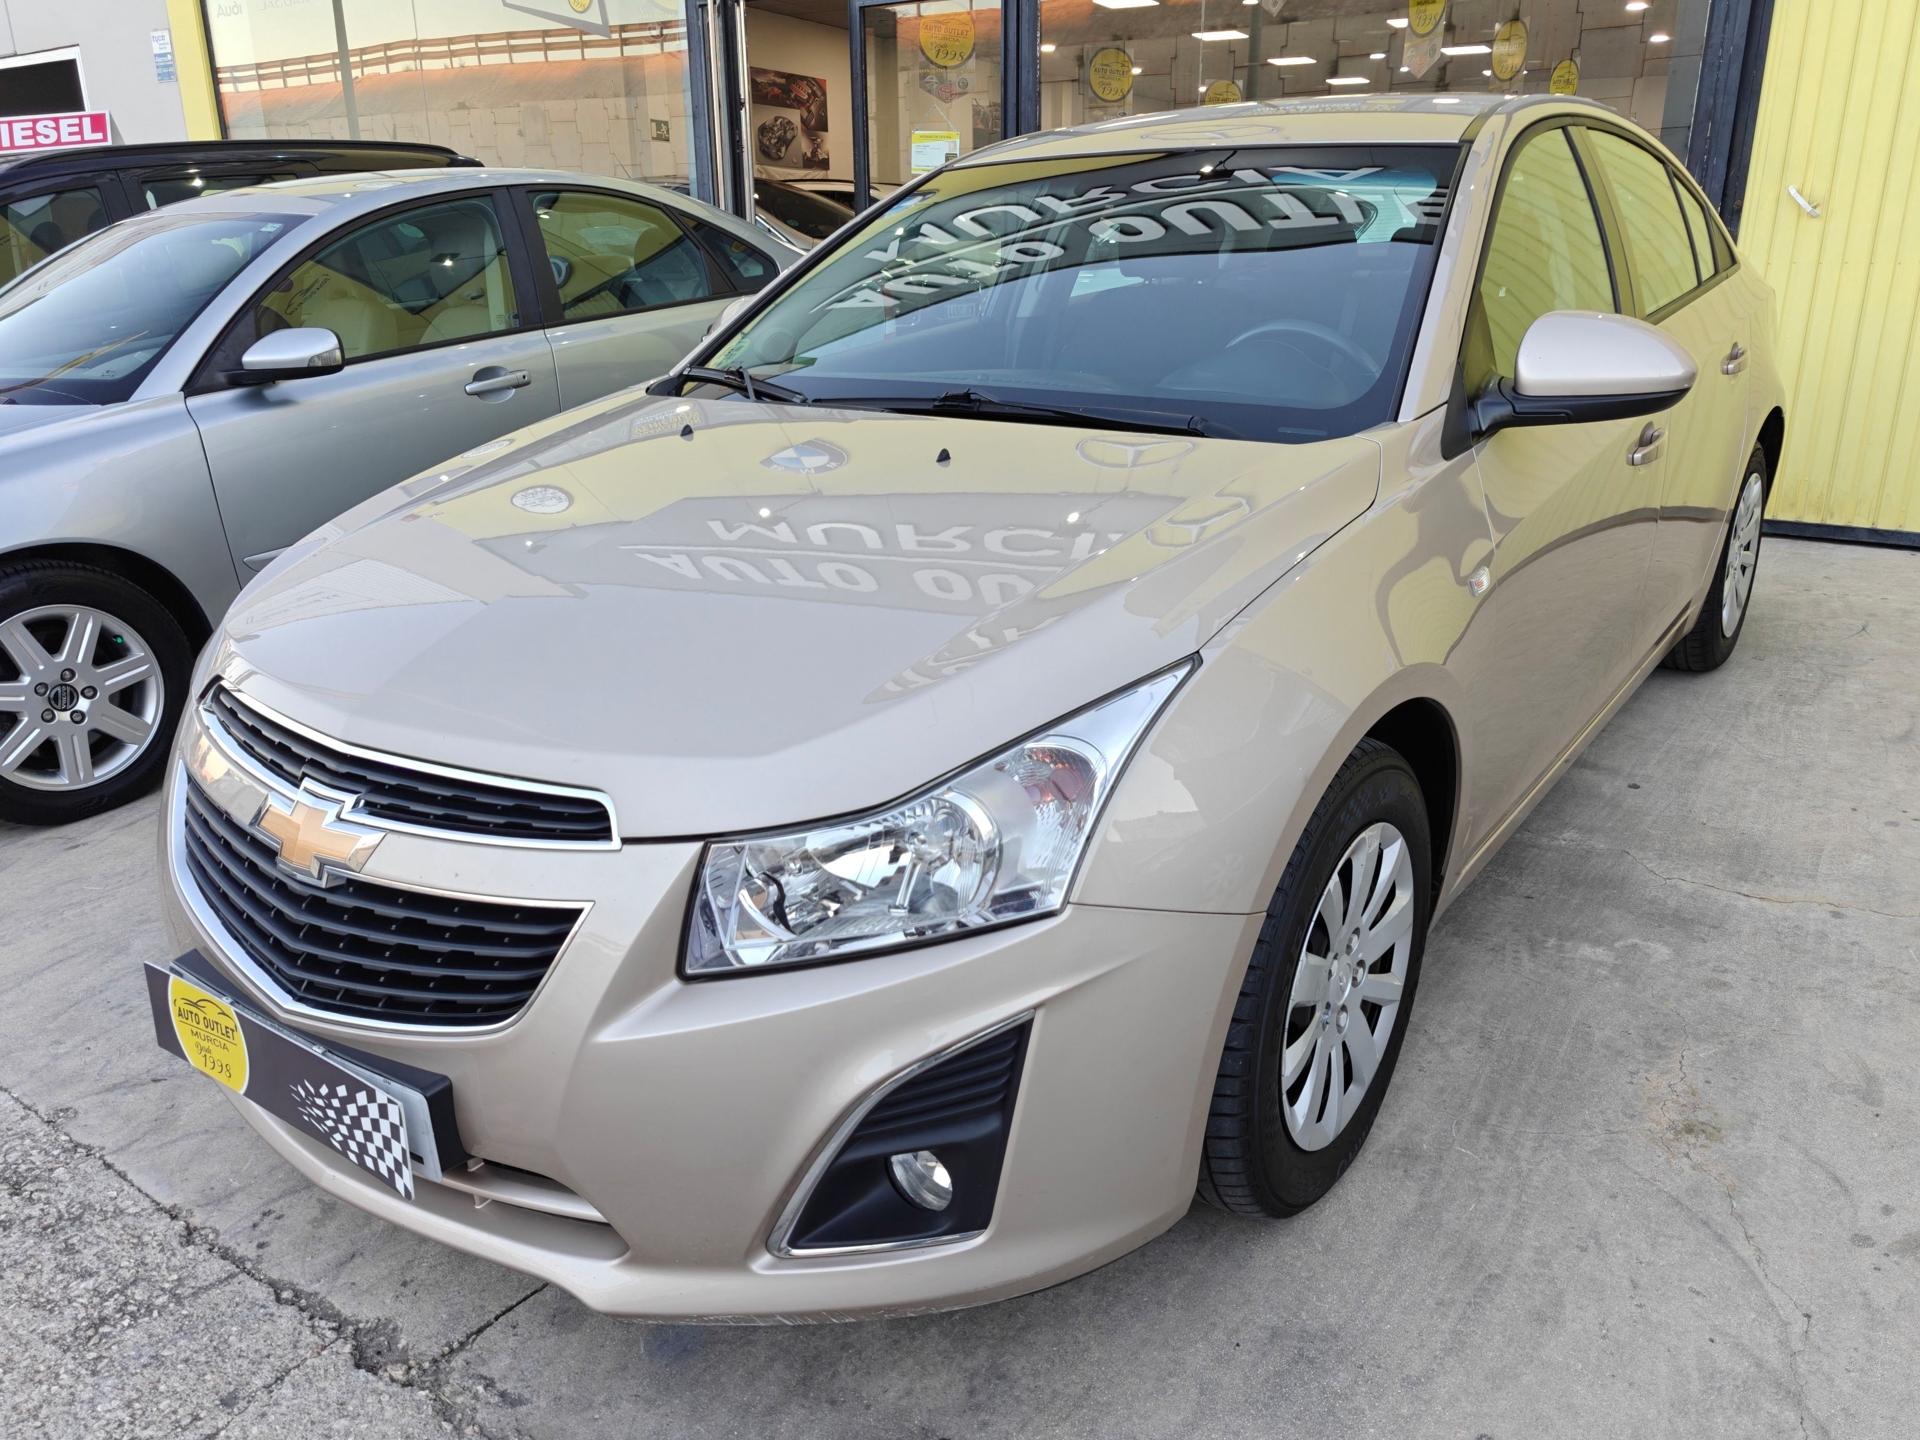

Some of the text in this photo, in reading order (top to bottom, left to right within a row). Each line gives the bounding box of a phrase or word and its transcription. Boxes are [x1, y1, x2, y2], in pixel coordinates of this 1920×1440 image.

[924, 24, 970, 36] AUTO OUTLET
[935, 48, 965, 61] 1998
[1101, 86, 1125, 97] 1998
[178, 1006, 235, 1041] AUTO OUTLET
[190, 1028, 230, 1053] MURCIA
[202, 1053, 232, 1079] 1998
